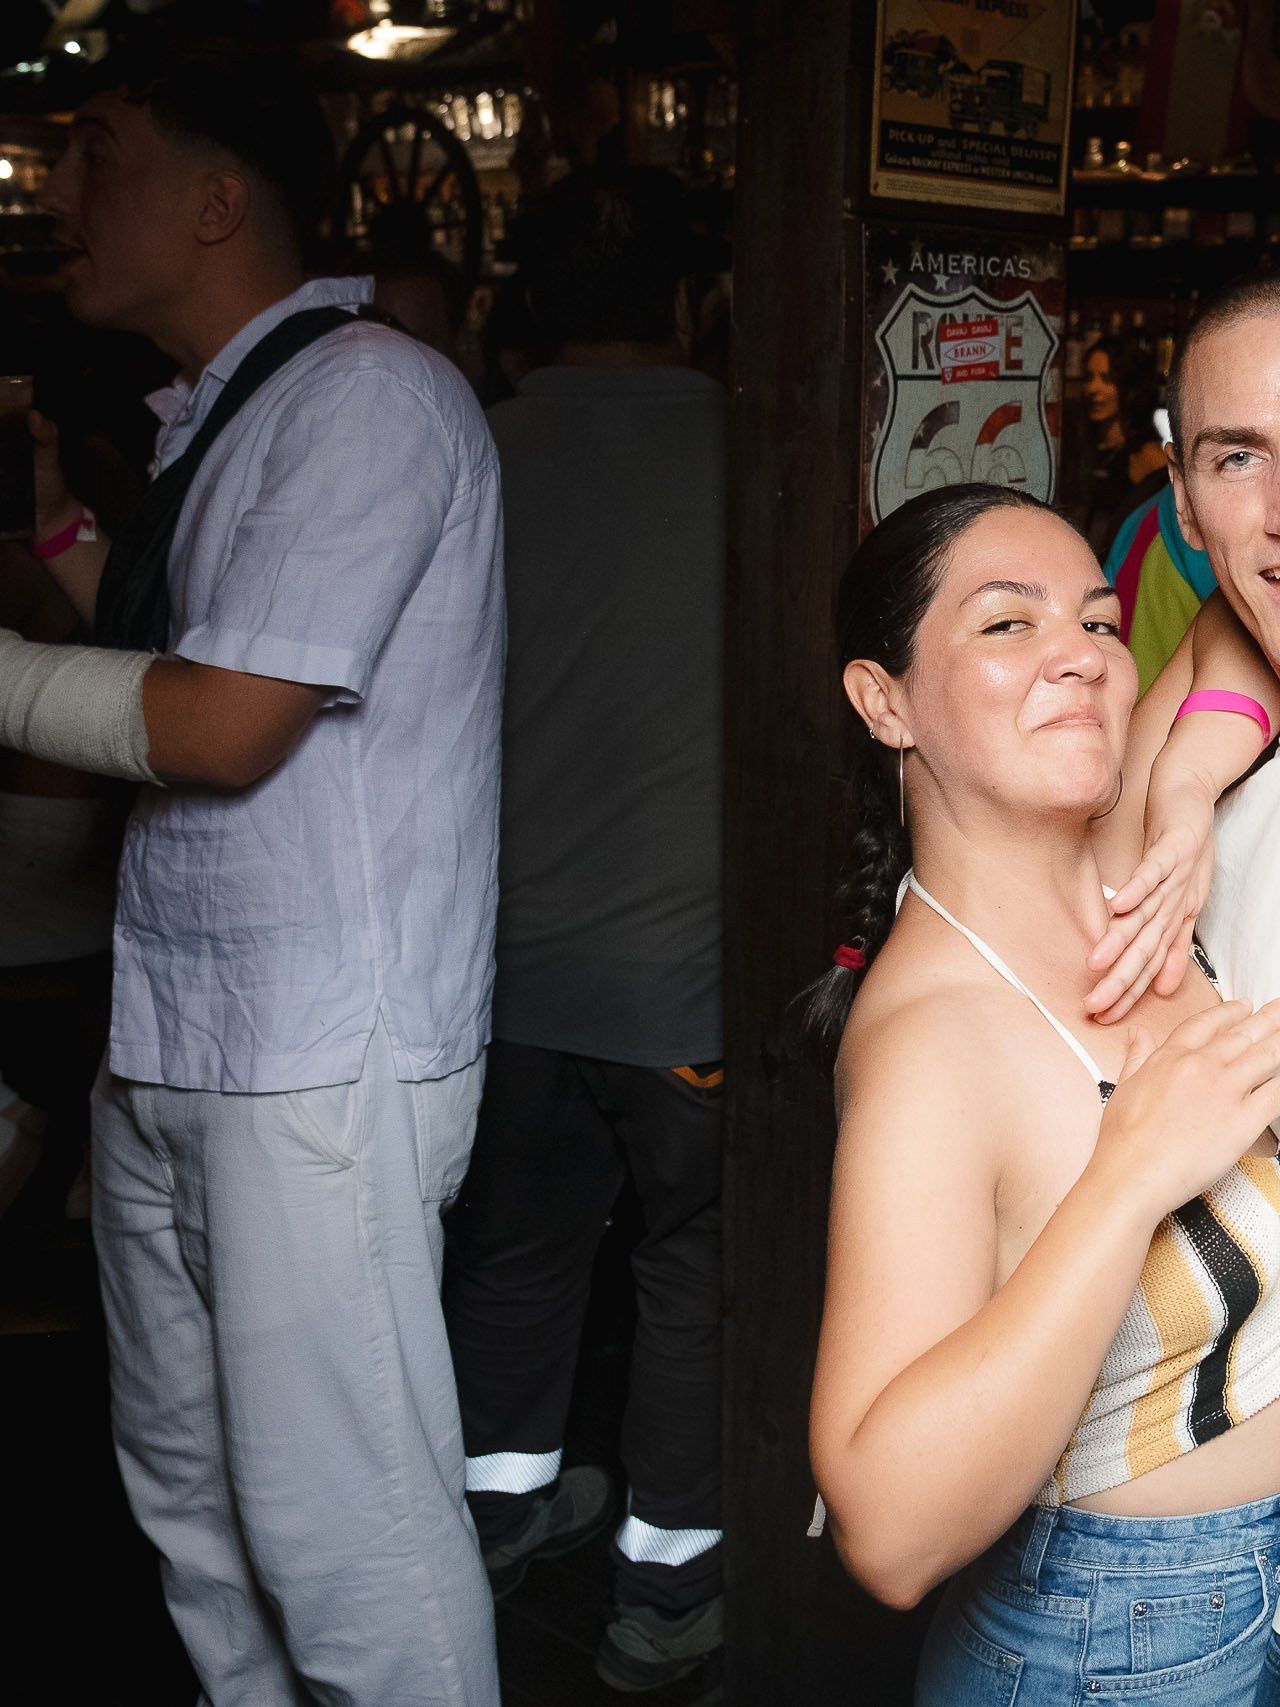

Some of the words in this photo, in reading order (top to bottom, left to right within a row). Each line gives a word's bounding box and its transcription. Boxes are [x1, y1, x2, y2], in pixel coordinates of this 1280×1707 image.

[960, 138, 1007, 155] SPECIAL
[1009, 145, 1058, 161] DELIVERY
[910, 251, 1032, 279] AMERICA'S
[911, 312, 1025, 370] ROE
[954, 345, 986, 358] BRANN
[904, 400, 1028, 489] 66
